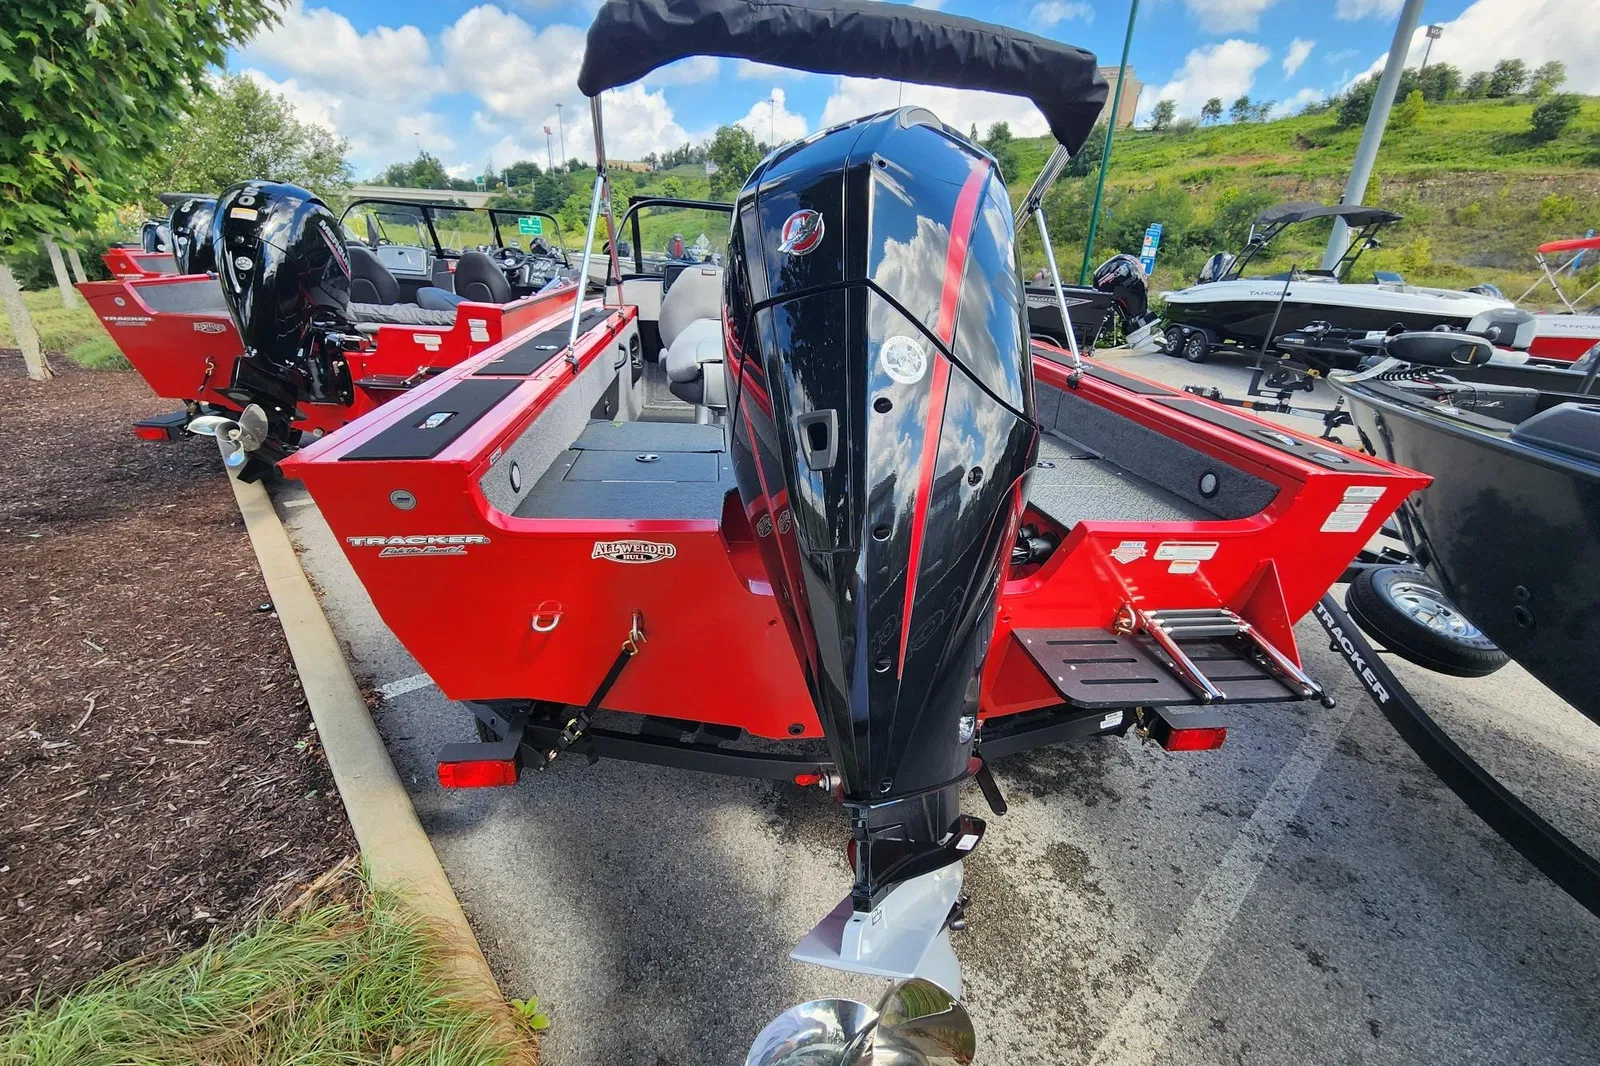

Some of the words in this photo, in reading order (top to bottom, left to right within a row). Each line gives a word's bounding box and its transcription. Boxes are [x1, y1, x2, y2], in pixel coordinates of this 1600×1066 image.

[319, 220, 350, 270] MERCUR
[347, 535, 486, 546] TRACKER
[1317, 601, 1390, 704] TRACKER
